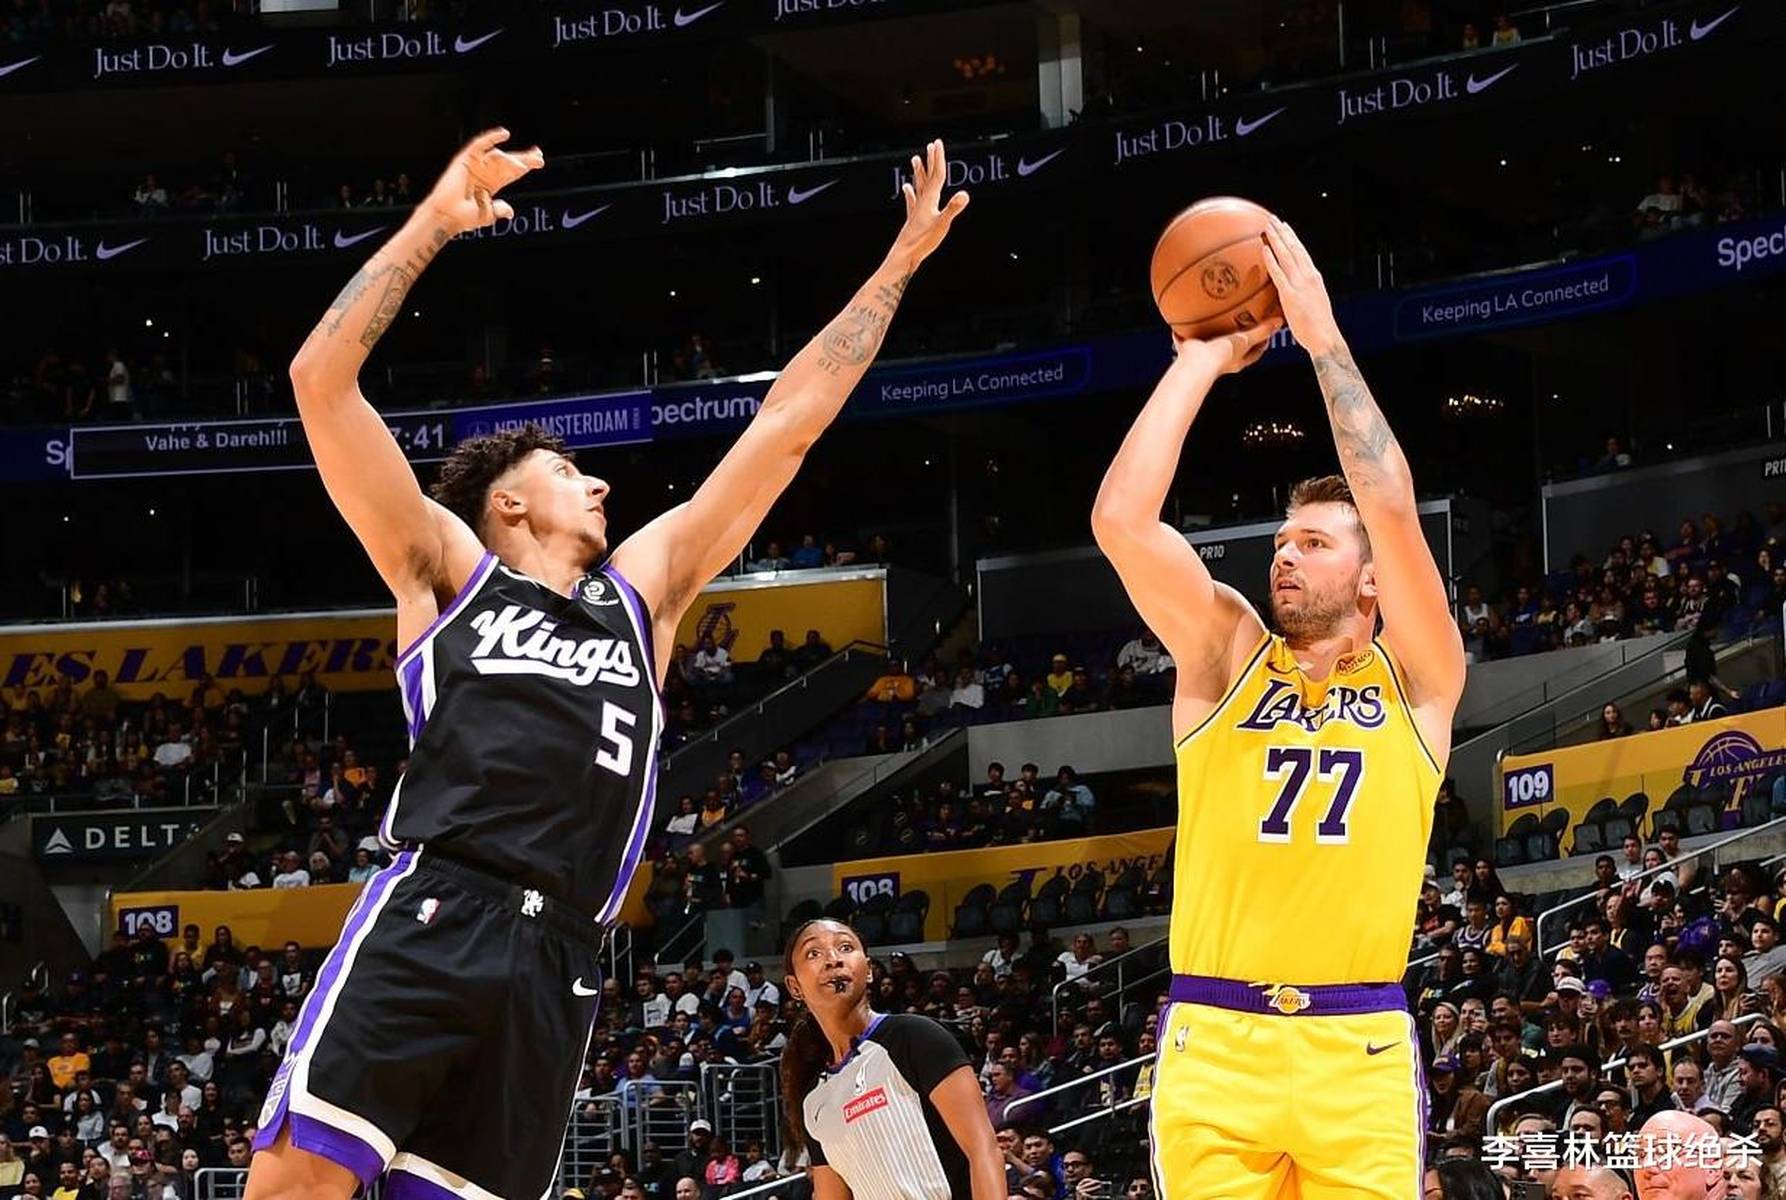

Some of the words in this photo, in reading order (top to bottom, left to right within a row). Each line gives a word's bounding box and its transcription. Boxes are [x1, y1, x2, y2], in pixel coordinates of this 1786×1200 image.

[553, 16, 599, 47] Just
[603, 9, 641, 35] Do
[645, 6, 666, 30] It.
[94, 47, 141, 78] Just
[148, 44, 187, 70] Do
[193, 43, 214, 67] It.
[327, 36, 374, 67] Just
[381, 33, 421, 58] Do
[426, 31, 446, 55] It.
[1571, 39, 1615, 80] Just
[1620, 29, 1657, 59] Do
[1662, 20, 1682, 48] It.
[1338, 86, 1385, 124] Just
[1391, 79, 1431, 108] Do
[1436, 72, 1458, 100] It.
[1114, 129, 1158, 165] Just
[1164, 122, 1202, 149] Do
[1207, 115, 1228, 141] It.
[947, 160, 984, 187] Do
[989, 155, 1009, 181] It.
[533, 207, 554, 232] It.
[661, 192, 709, 224] Just
[715, 185, 753, 212] Do
[759, 182, 779, 208] It.
[19, 238, 61, 263] Do
[65, 236, 88, 262] It.
[202, 230, 251, 260] Just
[257, 226, 298, 252] Do
[304, 224, 326, 250] It.
[1718, 226, 1786, 271] Spec
[1423, 300, 1490, 323] Keeping
[1495, 292, 1518, 312] LA
[1521, 273, 1609, 308] Connected
[881, 380, 949, 402] Keeping
[952, 377, 975, 394] LA
[977, 362, 1064, 392] Connected
[145, 433, 190, 451] Vahe
[196, 433, 209, 449] &
[216, 429, 287, 448] Dareh!!!
[470, 605, 640, 688] Kings
[594, 701, 637, 776] 5
[1732, 755, 1786, 774] ANGELE
[1258, 745, 1375, 845] 77
[1509, 770, 1550, 803] 109
[847, 877, 895, 903] 108
[125, 910, 172, 935] 108
[846, 1092, 887, 1119] Emirates
